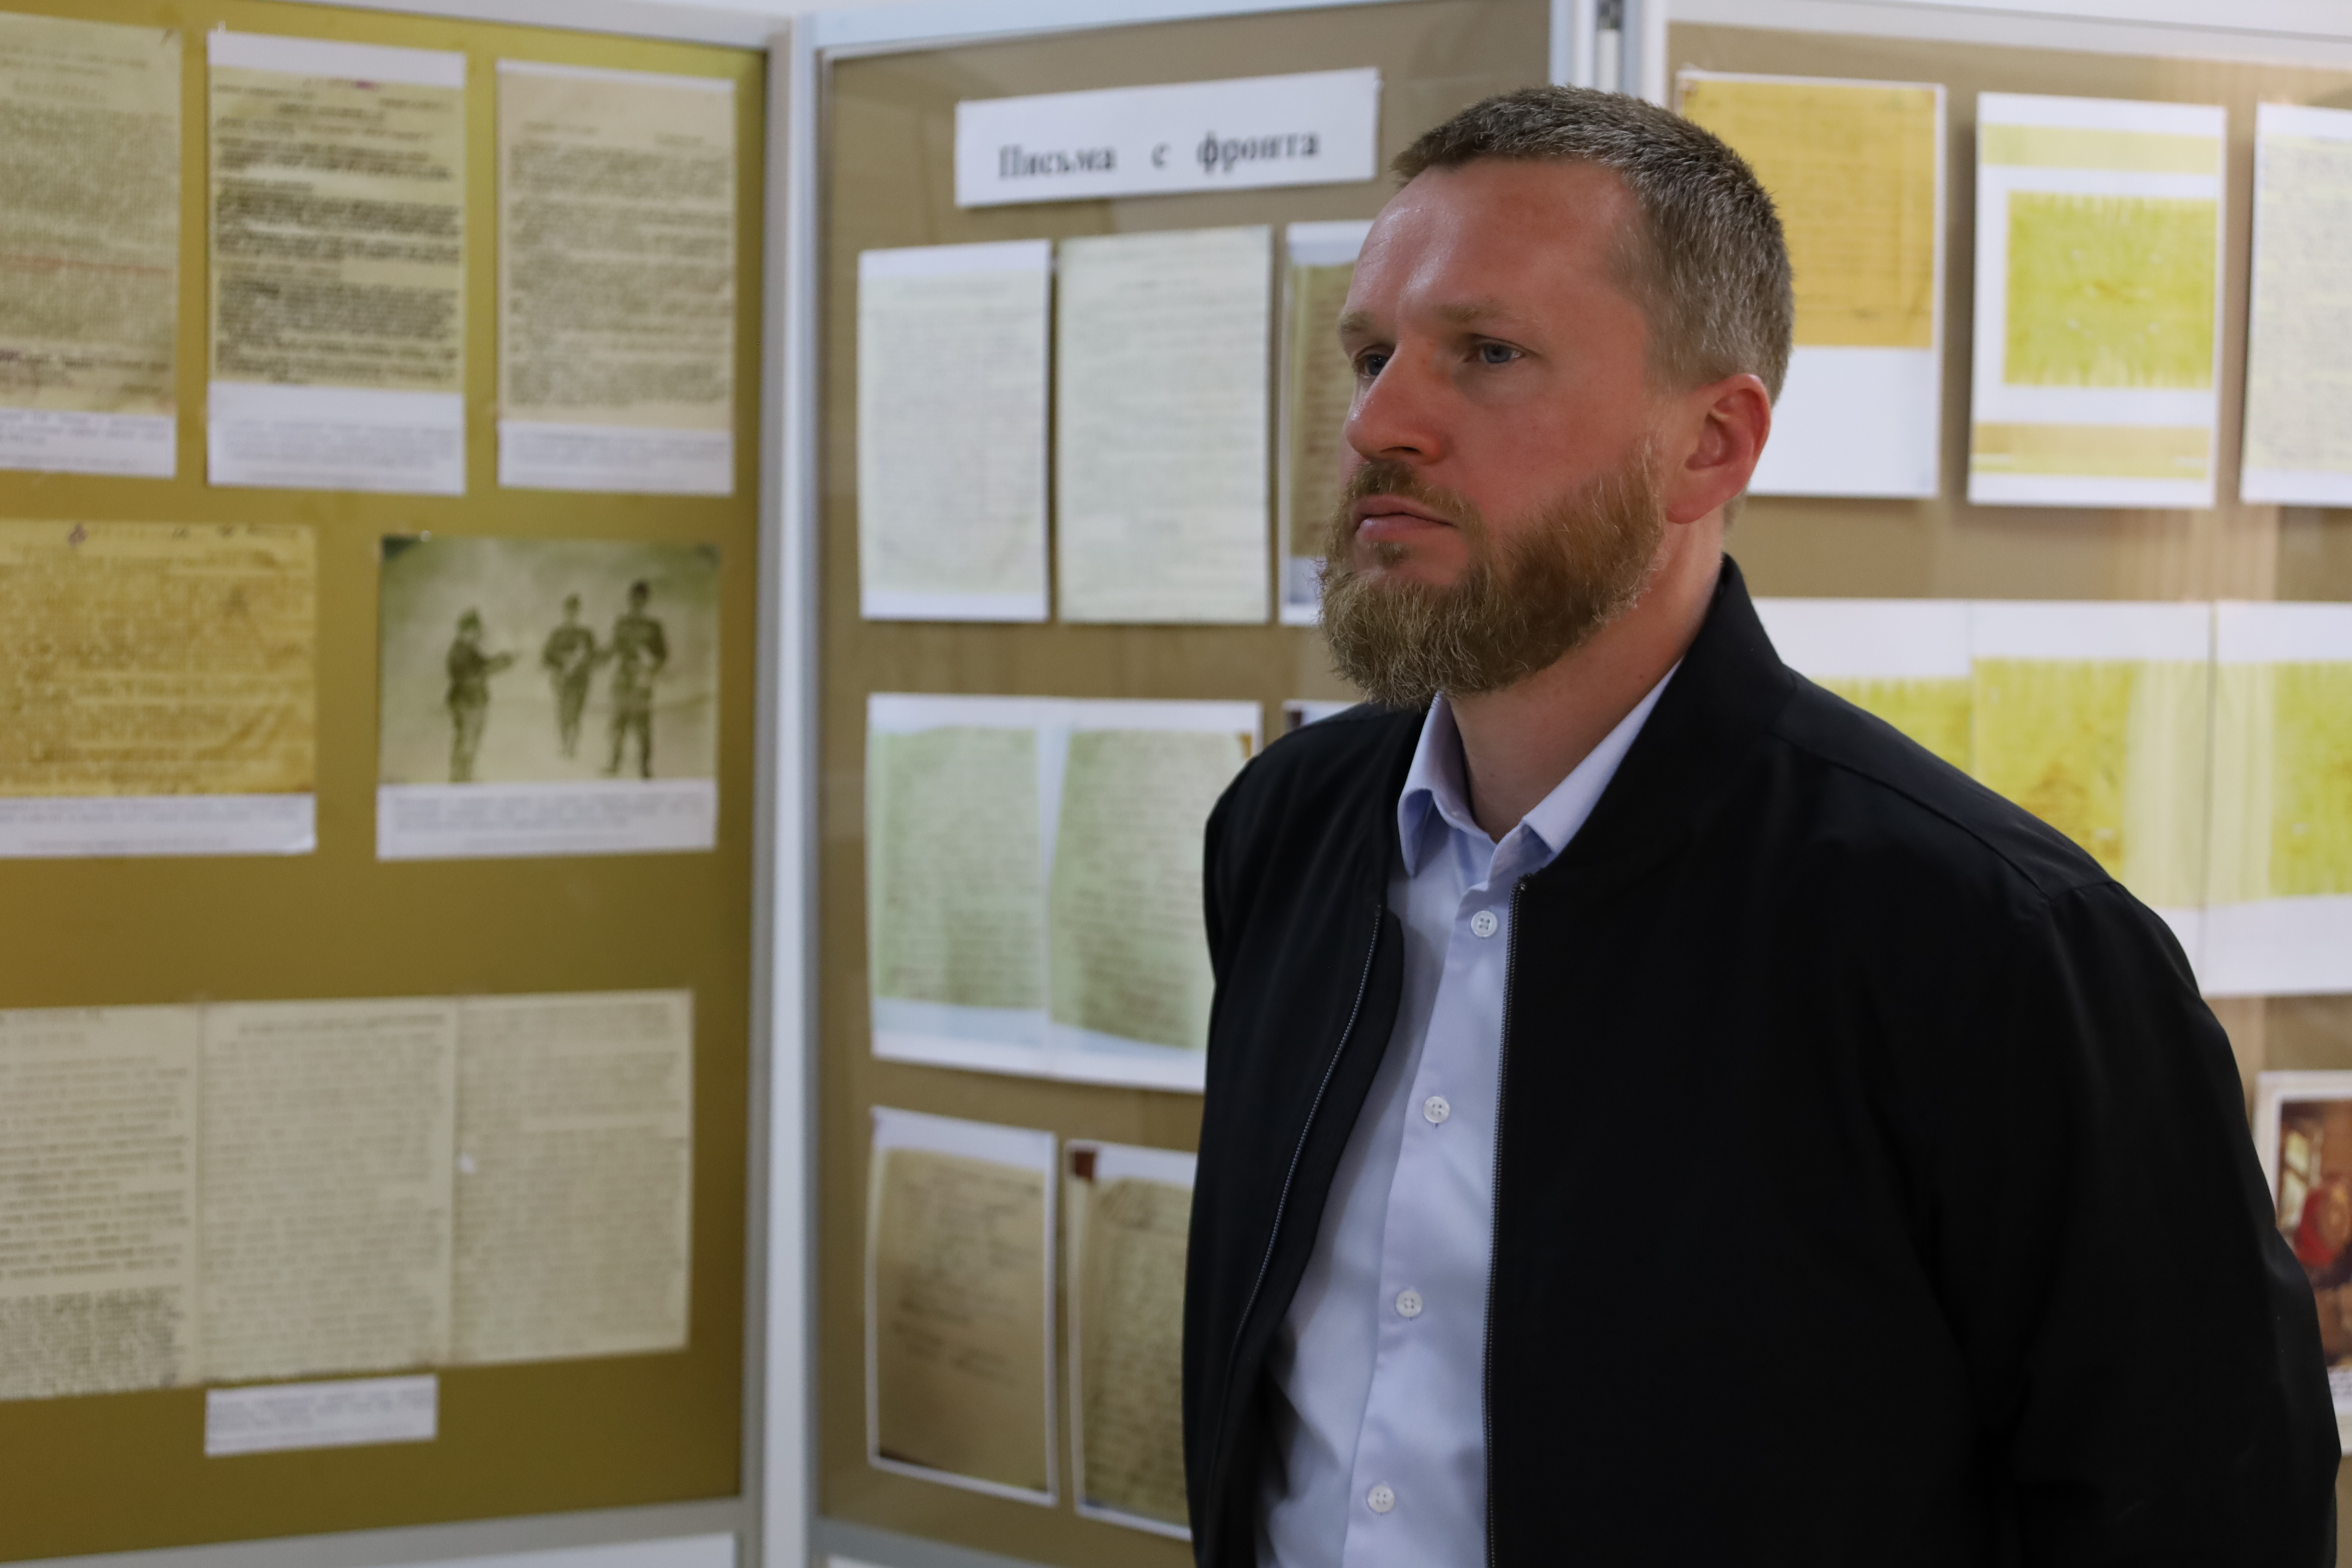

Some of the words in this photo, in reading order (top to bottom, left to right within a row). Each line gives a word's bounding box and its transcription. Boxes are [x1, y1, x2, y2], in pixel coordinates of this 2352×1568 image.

[998, 142, 1116, 179] Письма
[1150, 142, 1168, 168] с
[1196, 130, 1319, 173] фронта
